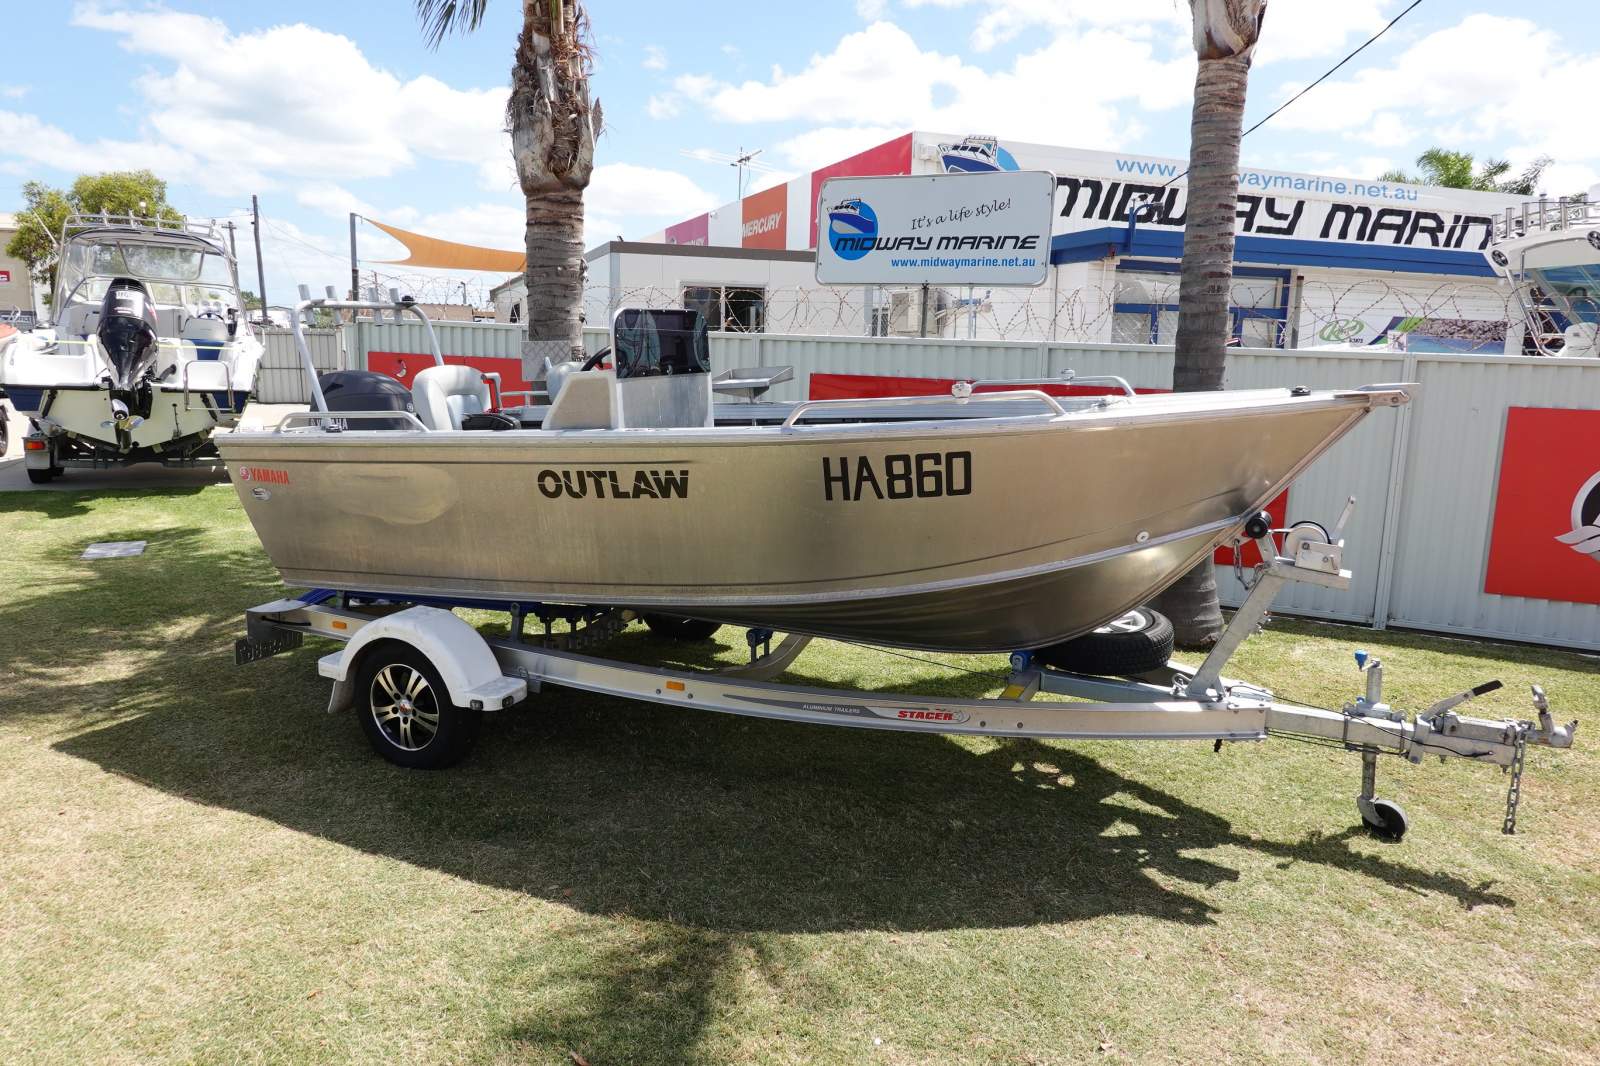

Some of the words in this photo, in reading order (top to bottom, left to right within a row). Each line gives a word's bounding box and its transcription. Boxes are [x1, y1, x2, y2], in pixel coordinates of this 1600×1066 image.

[911, 216, 932, 230] It's
[935, 215, 947, 225] a
[950, 206, 974, 222] life
[975, 198, 1011, 217] style!
[742, 213, 782, 238] MERCURY
[834, 236, 933, 251] MIDWAY
[936, 235, 1040, 250] MARINE
[891, 257, 1036, 270] www.midwaymarine.net.au
[250, 467, 290, 485] YAMAHA
[537, 469, 689, 499] OUTLAW
[822, 450, 972, 501] HA860
[897, 710, 953, 721] STACER
